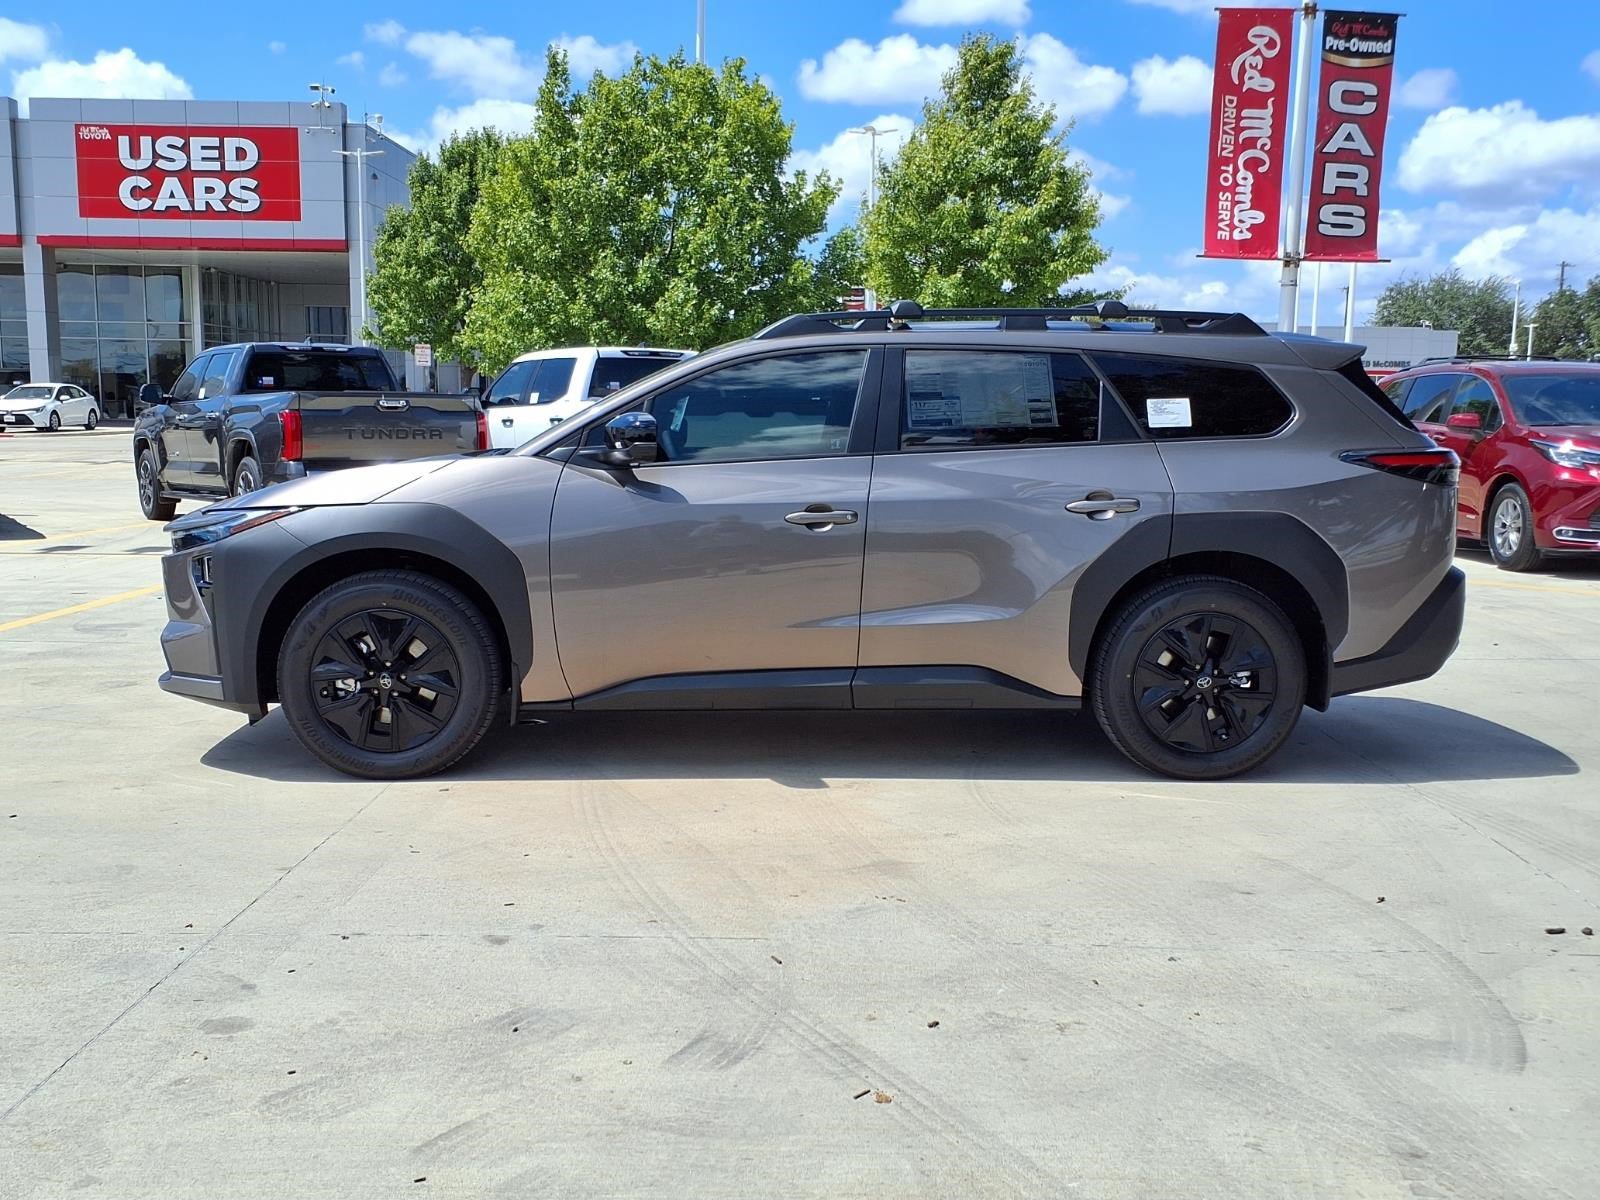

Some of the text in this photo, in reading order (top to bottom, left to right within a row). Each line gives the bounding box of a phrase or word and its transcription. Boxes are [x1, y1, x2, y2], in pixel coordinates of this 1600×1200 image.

[1231, 25, 1281, 92] Red
[1325, 36, 1392, 54] Pre-Owned
[79, 132, 111, 140] TOYOTA
[117, 135, 259, 171] USED
[1217, 94, 1237, 240] DRIVEN TO SERVE
[1318, 80, 1378, 237] CARS
[118, 175, 261, 212] CARS
[1362, 360, 1371, 368] ED
[342, 427, 443, 440] TUNDRA
